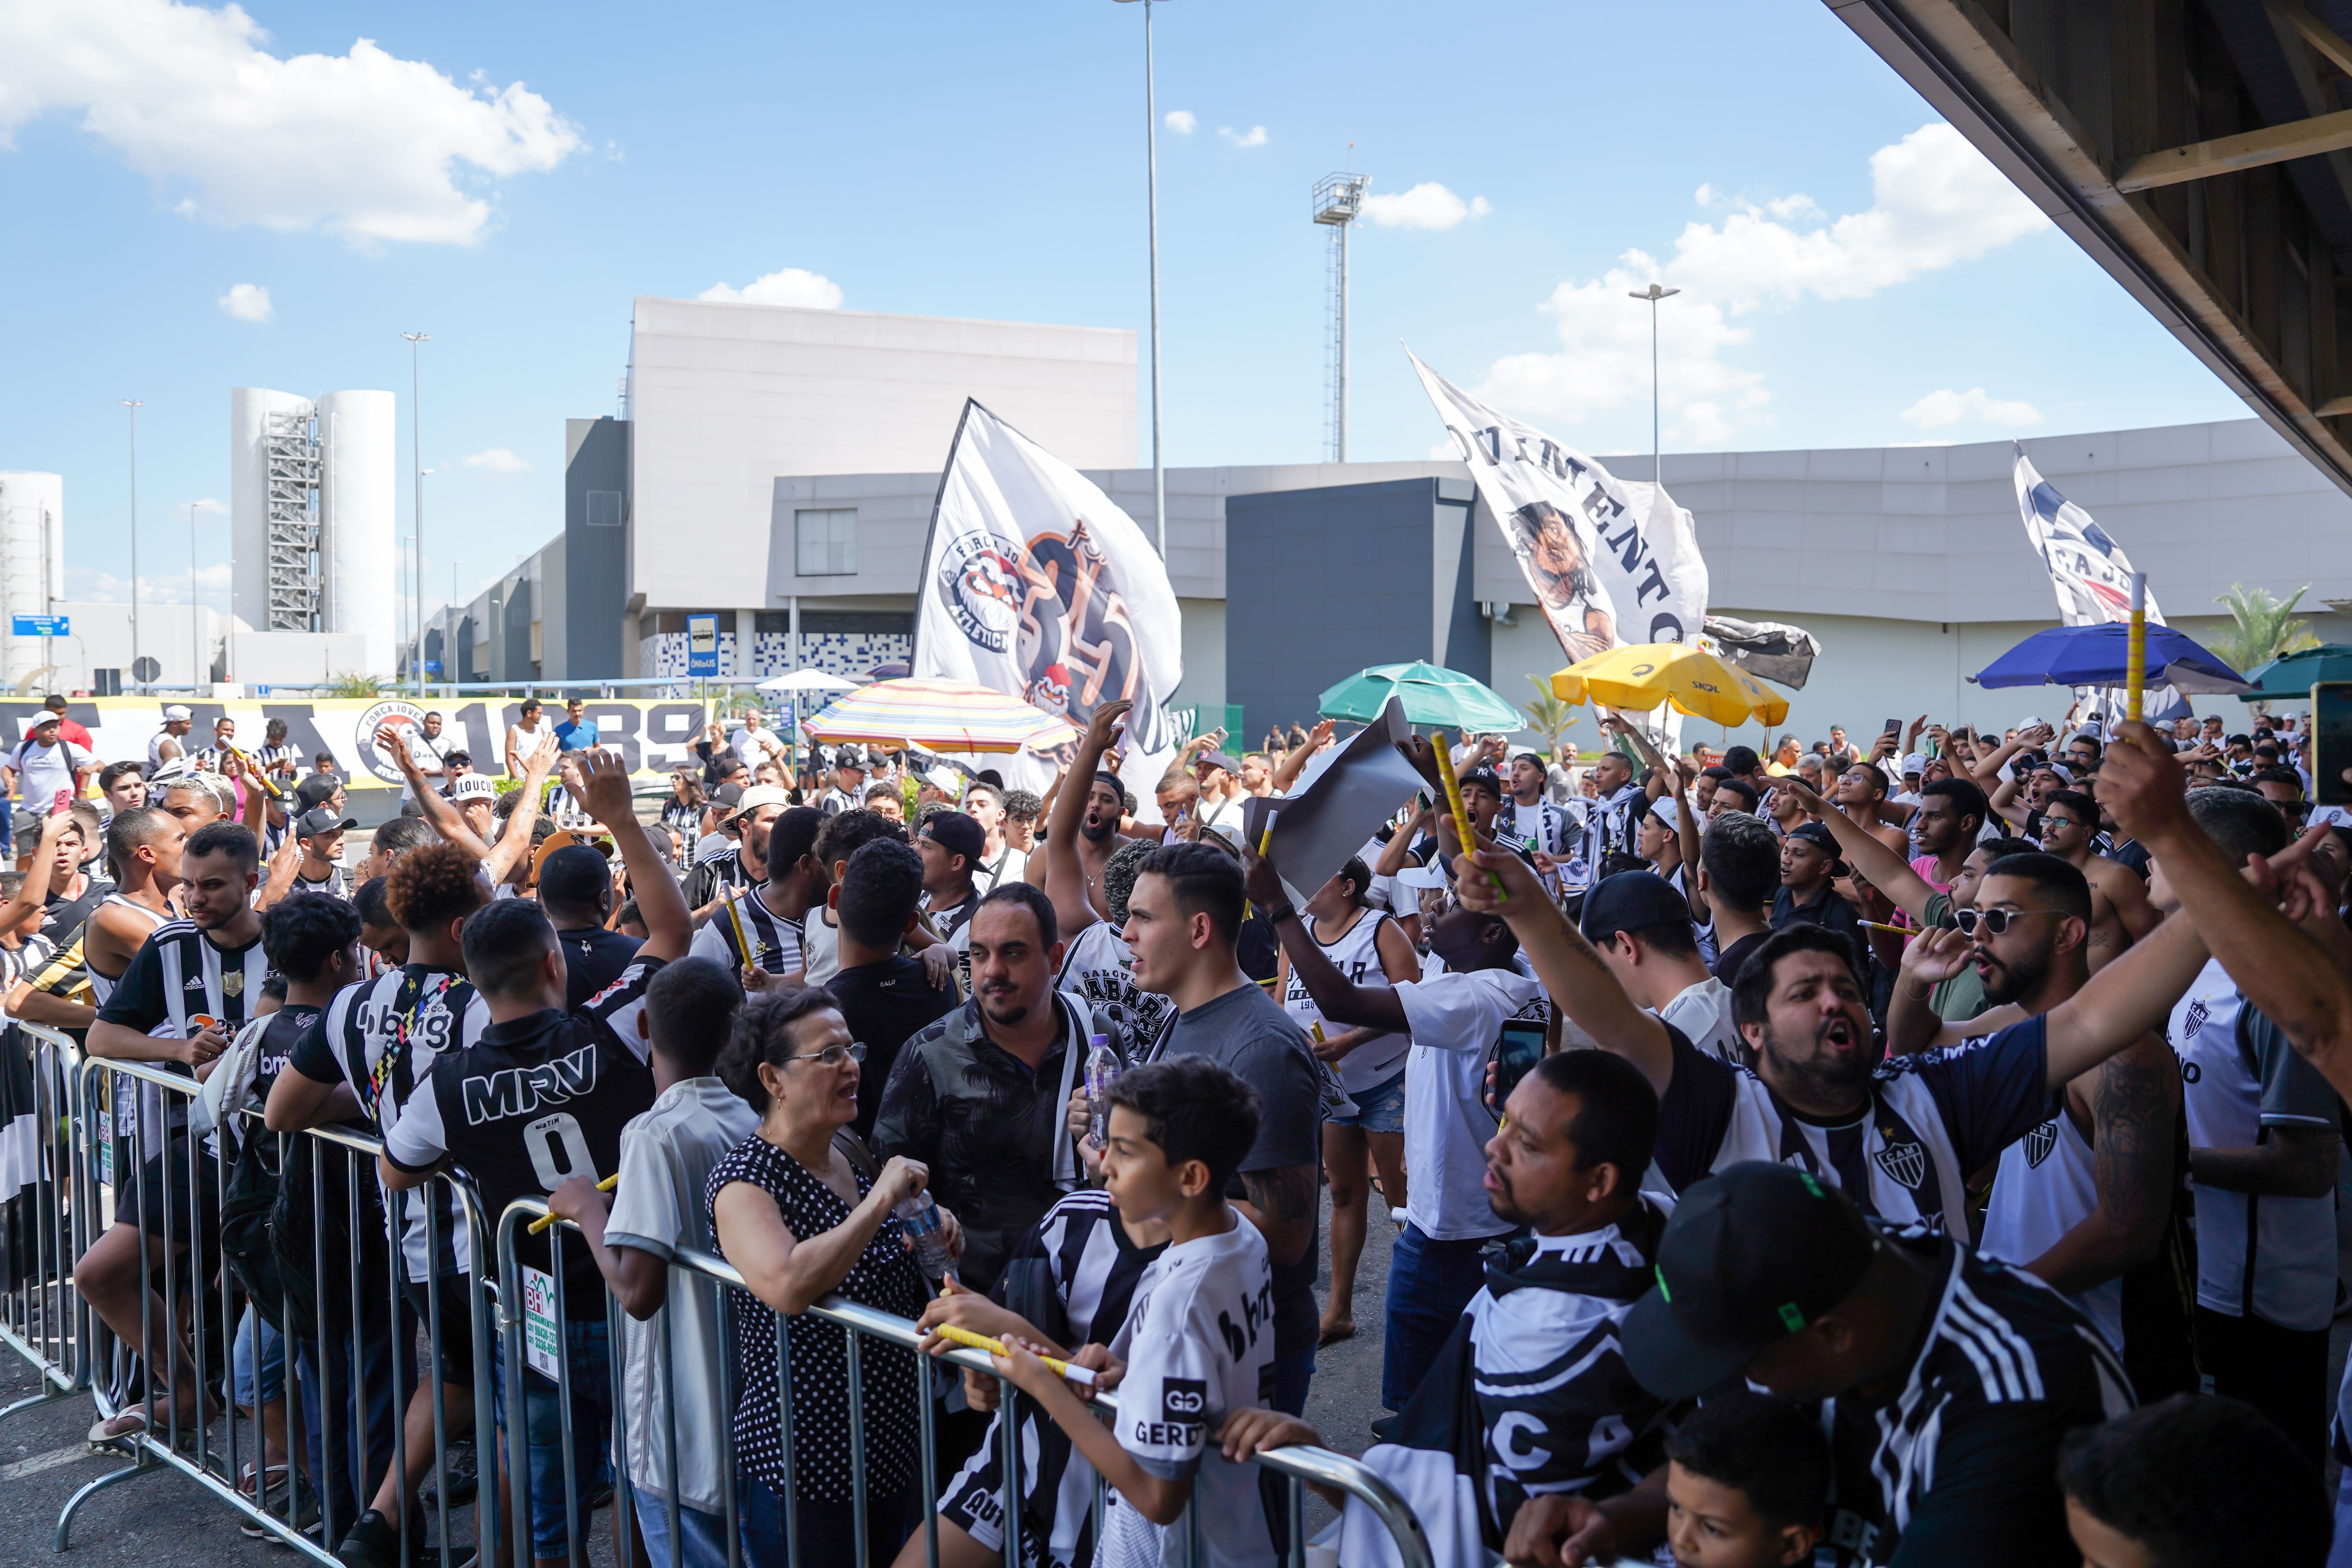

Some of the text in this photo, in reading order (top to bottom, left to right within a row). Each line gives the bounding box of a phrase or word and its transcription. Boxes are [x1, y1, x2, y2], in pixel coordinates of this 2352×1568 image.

[1692, 681, 1720, 693] SKOL
[880, 979, 896, 987] GALO
[462, 1043, 596, 1125] MRV
[546, 1117, 560, 1126] TIM
[1886, 1146, 1915, 1162] CAM
[526, 1286, 543, 1315] BH
